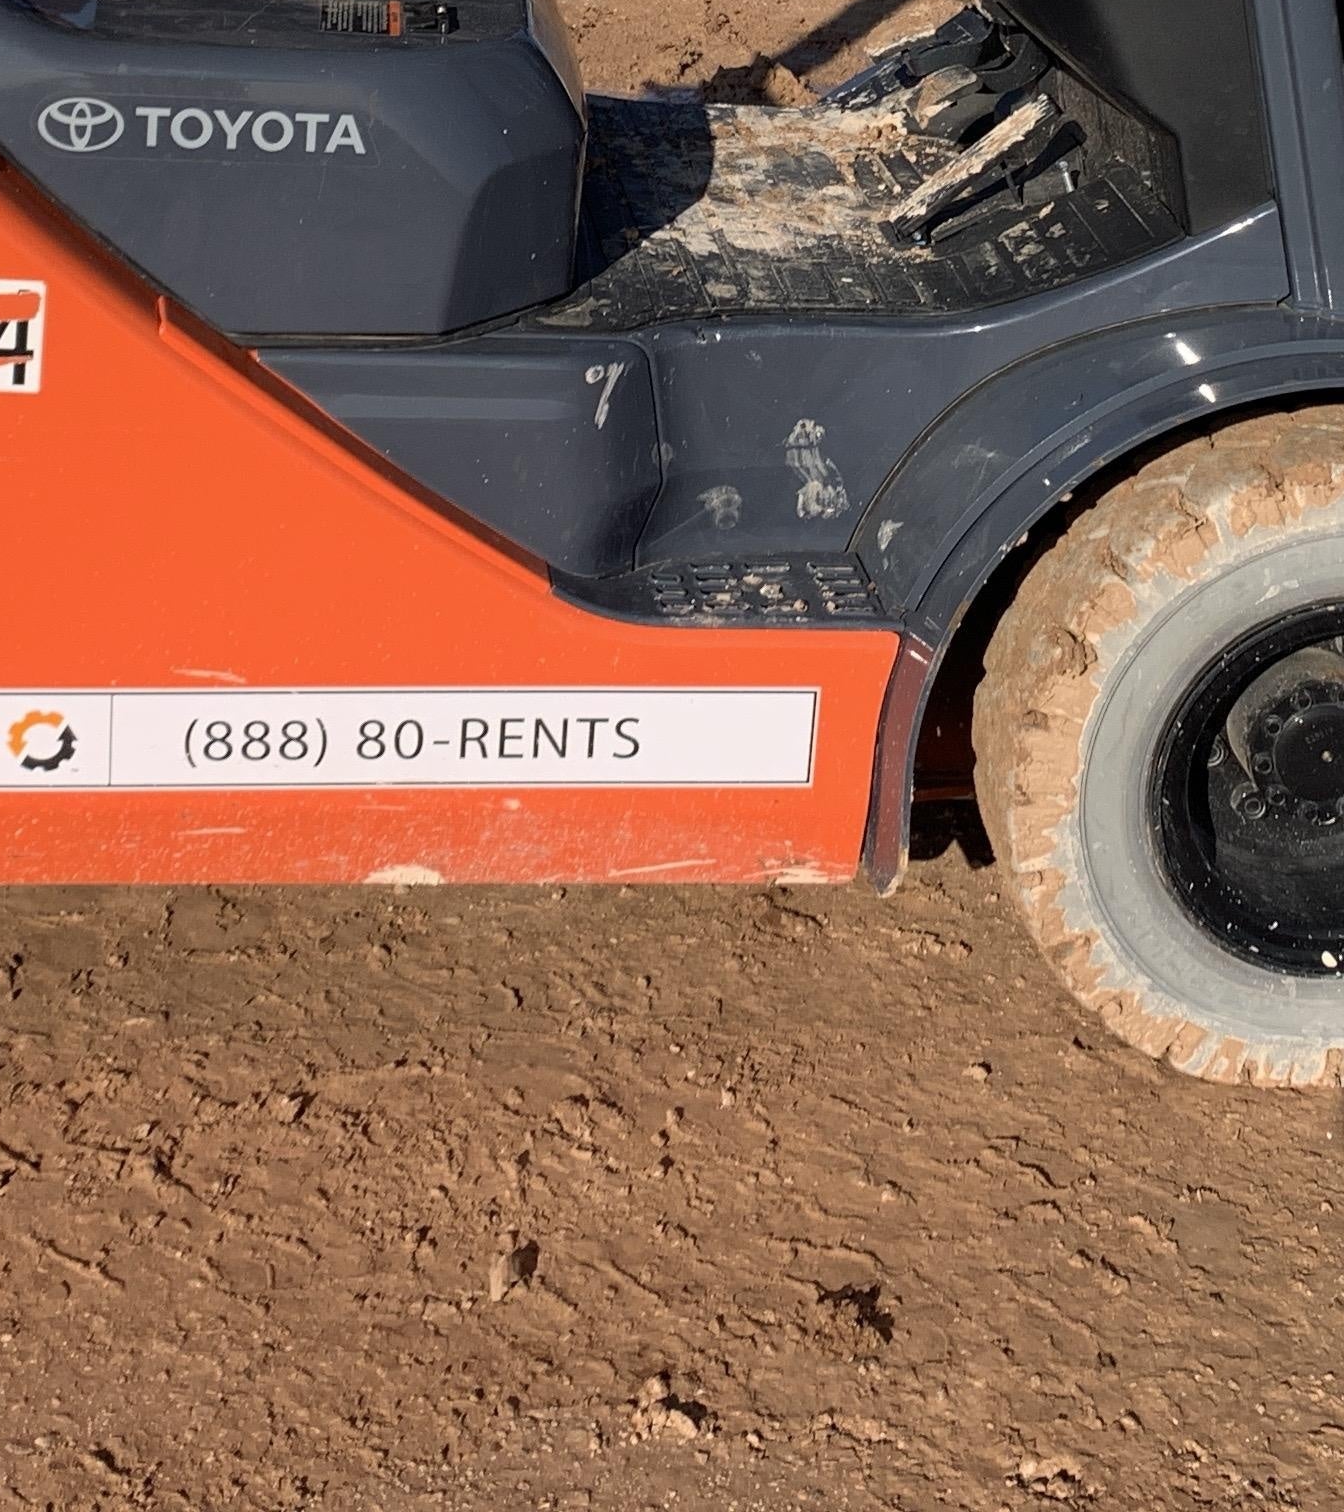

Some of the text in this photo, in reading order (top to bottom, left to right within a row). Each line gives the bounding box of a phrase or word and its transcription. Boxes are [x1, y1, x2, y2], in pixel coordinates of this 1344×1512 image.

[135, 106, 367, 155] TOYOTA
[184, 717, 641, 768] (888) 80-RENTS
